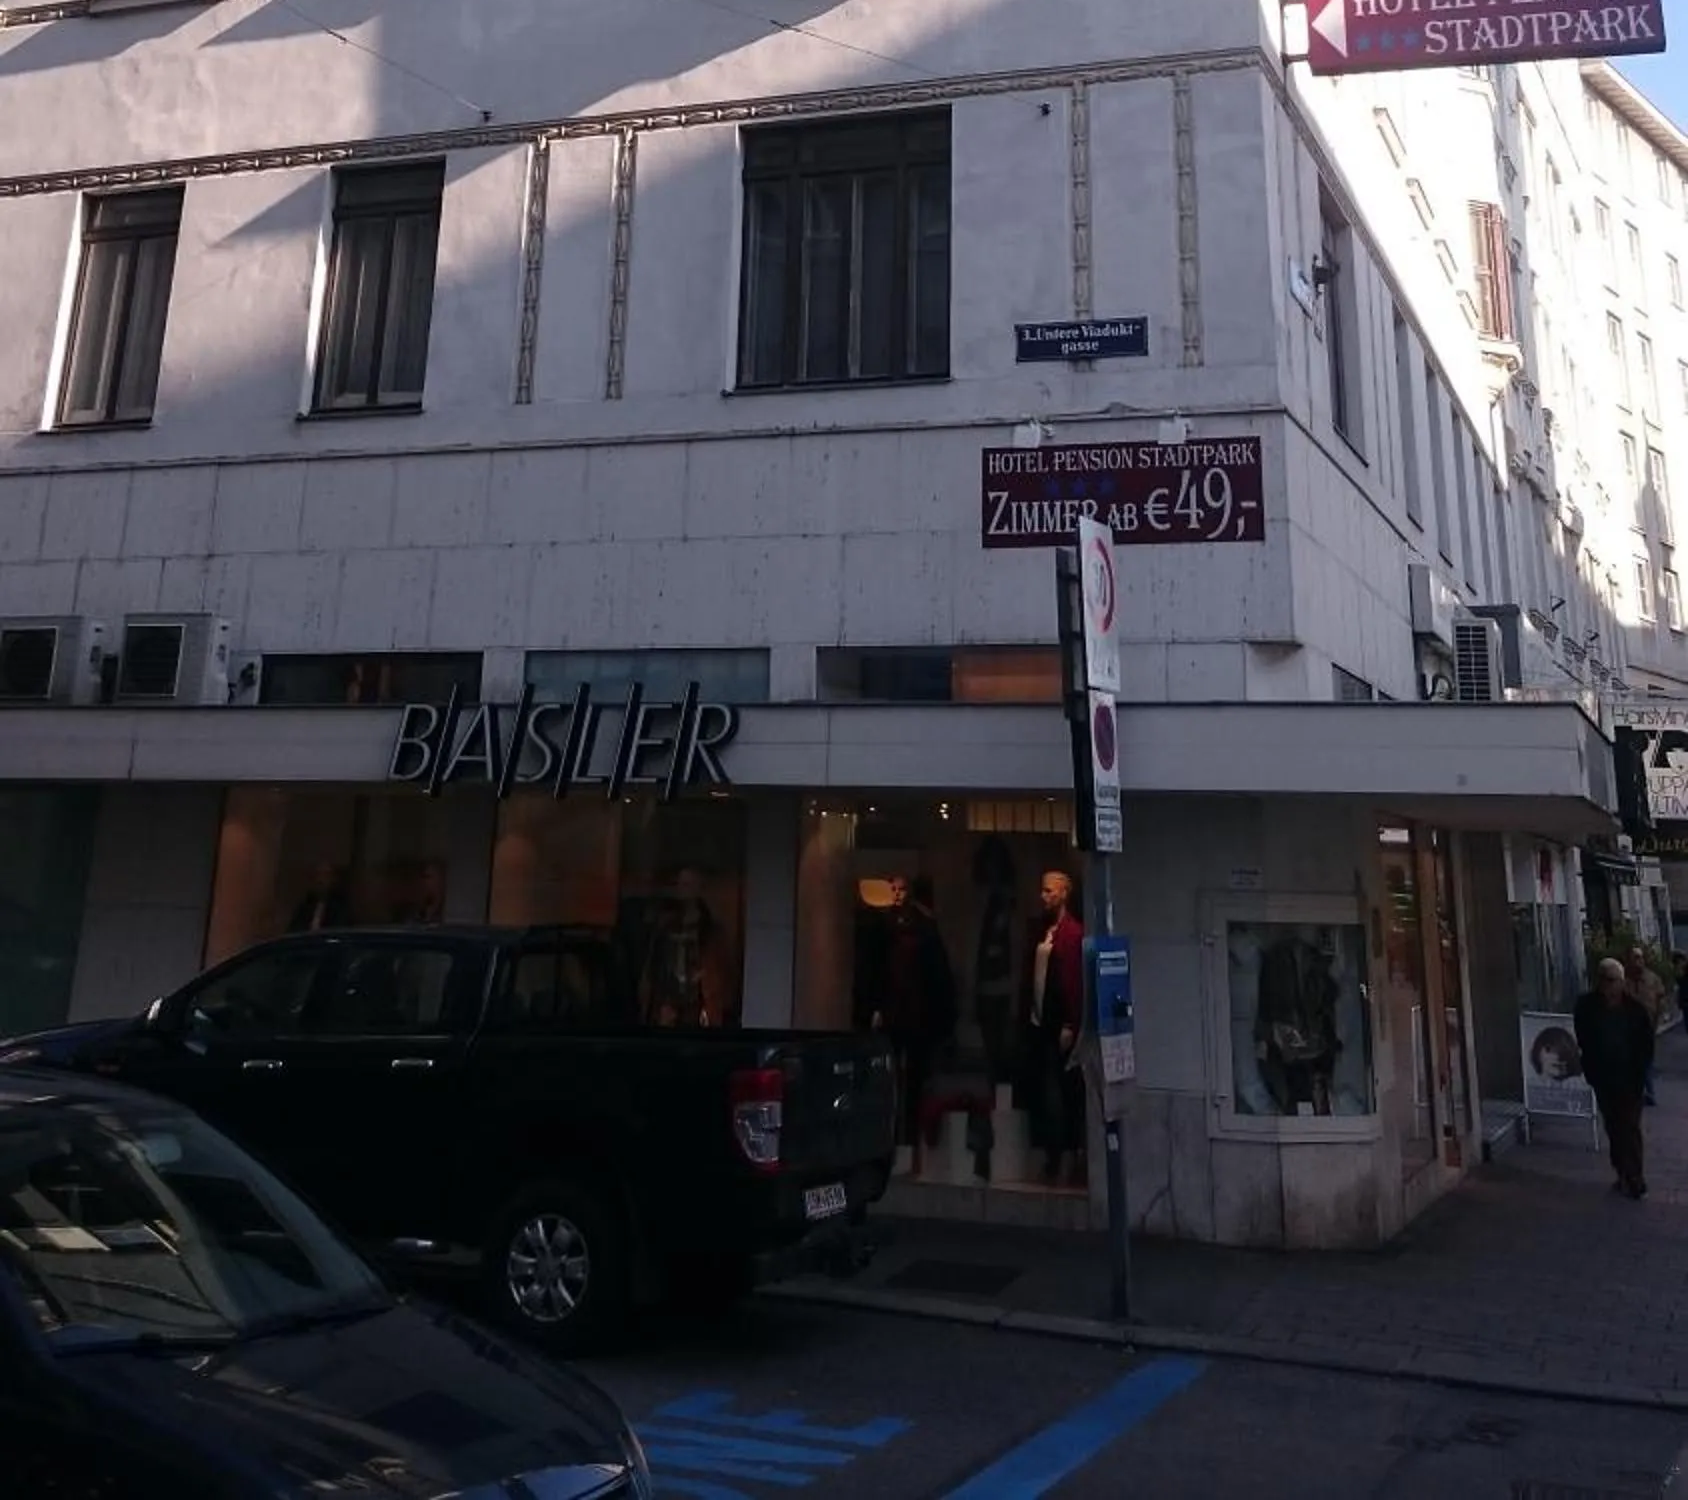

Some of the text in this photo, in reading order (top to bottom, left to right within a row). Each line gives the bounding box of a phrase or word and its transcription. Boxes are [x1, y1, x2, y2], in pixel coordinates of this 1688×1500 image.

[1423, 4, 1656, 54] STADTPARK
[1060, 340, 1100, 355] gasse
[987, 442, 1257, 476] HOTEL PENSION STADTPARK
[1107, 502, 1139, 531] AB
[1612, 704, 1688, 728] Hairstylin
[388, 702, 740, 786] BASLER
